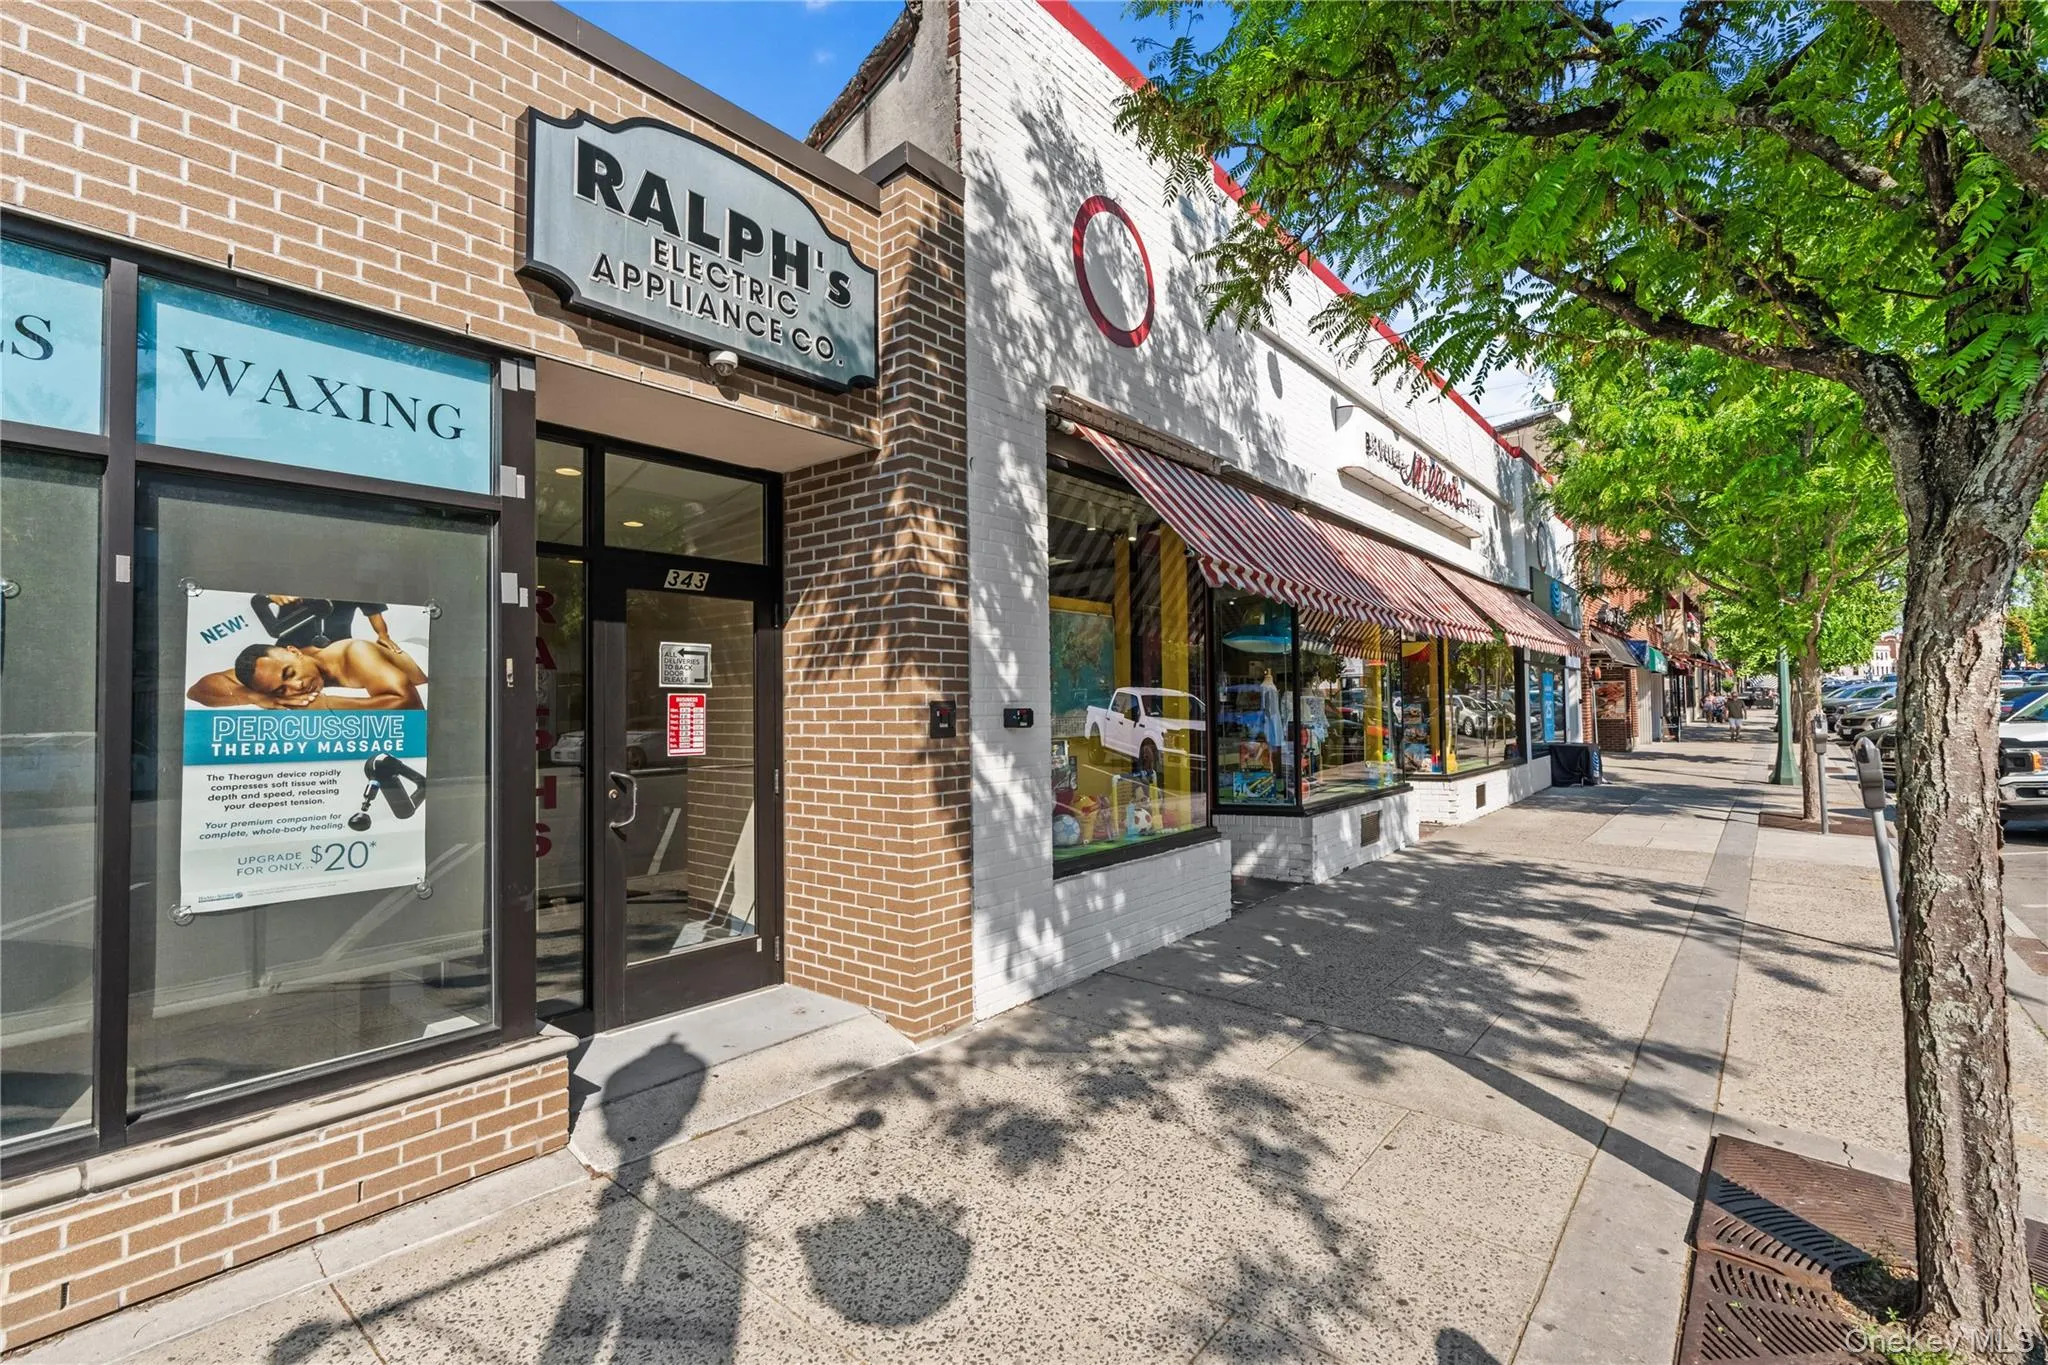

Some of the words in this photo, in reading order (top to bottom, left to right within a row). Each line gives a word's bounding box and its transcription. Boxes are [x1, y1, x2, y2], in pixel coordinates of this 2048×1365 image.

[574, 136, 852, 308] RALPH'S
[651, 236, 799, 318] ELECTRIC
[589, 252, 783, 345] APPLIANCE
[790, 326, 845, 367] CO.
[0, 314, 54, 361] S
[177, 346, 465, 441] WAXING
[668, 571, 706, 589] 343
[200, 615, 249, 644] NEW!
[664, 657, 700, 666] DELIVERIES
[674, 664, 694, 672] BACK
[213, 715, 405, 742] PERCUSSIVE
[211, 741, 308, 757] THERAPY
[318, 739, 404, 754] MASSAGE
[206, 774, 225, 782] The
[228, 772, 274, 781] Theragun
[276, 770, 307, 778] device
[309, 769, 342, 778] rapidly
[210, 783, 269, 792] compresses
[271, 781, 289, 789] soft
[319, 778, 338, 786] with
[207, 793, 238, 802] depth
[240, 791, 260, 799] and
[263, 790, 296, 799] speed,
[298, 788, 340, 796] releasing
[223, 803, 246, 812] your
[248, 800, 288, 809] deepest
[290, 798, 326, 806] tension.
[205, 821, 228, 830] Your
[230, 819, 274, 829] premium
[276, 815, 328, 824] companion
[329, 813, 342, 821] for
[199, 830, 249, 840] complete,
[252, 825, 308, 836] whole-body
[310, 822, 346, 831] healing.
[237, 851, 302, 866] UPGRADE
[236, 866, 264, 877] FOR
